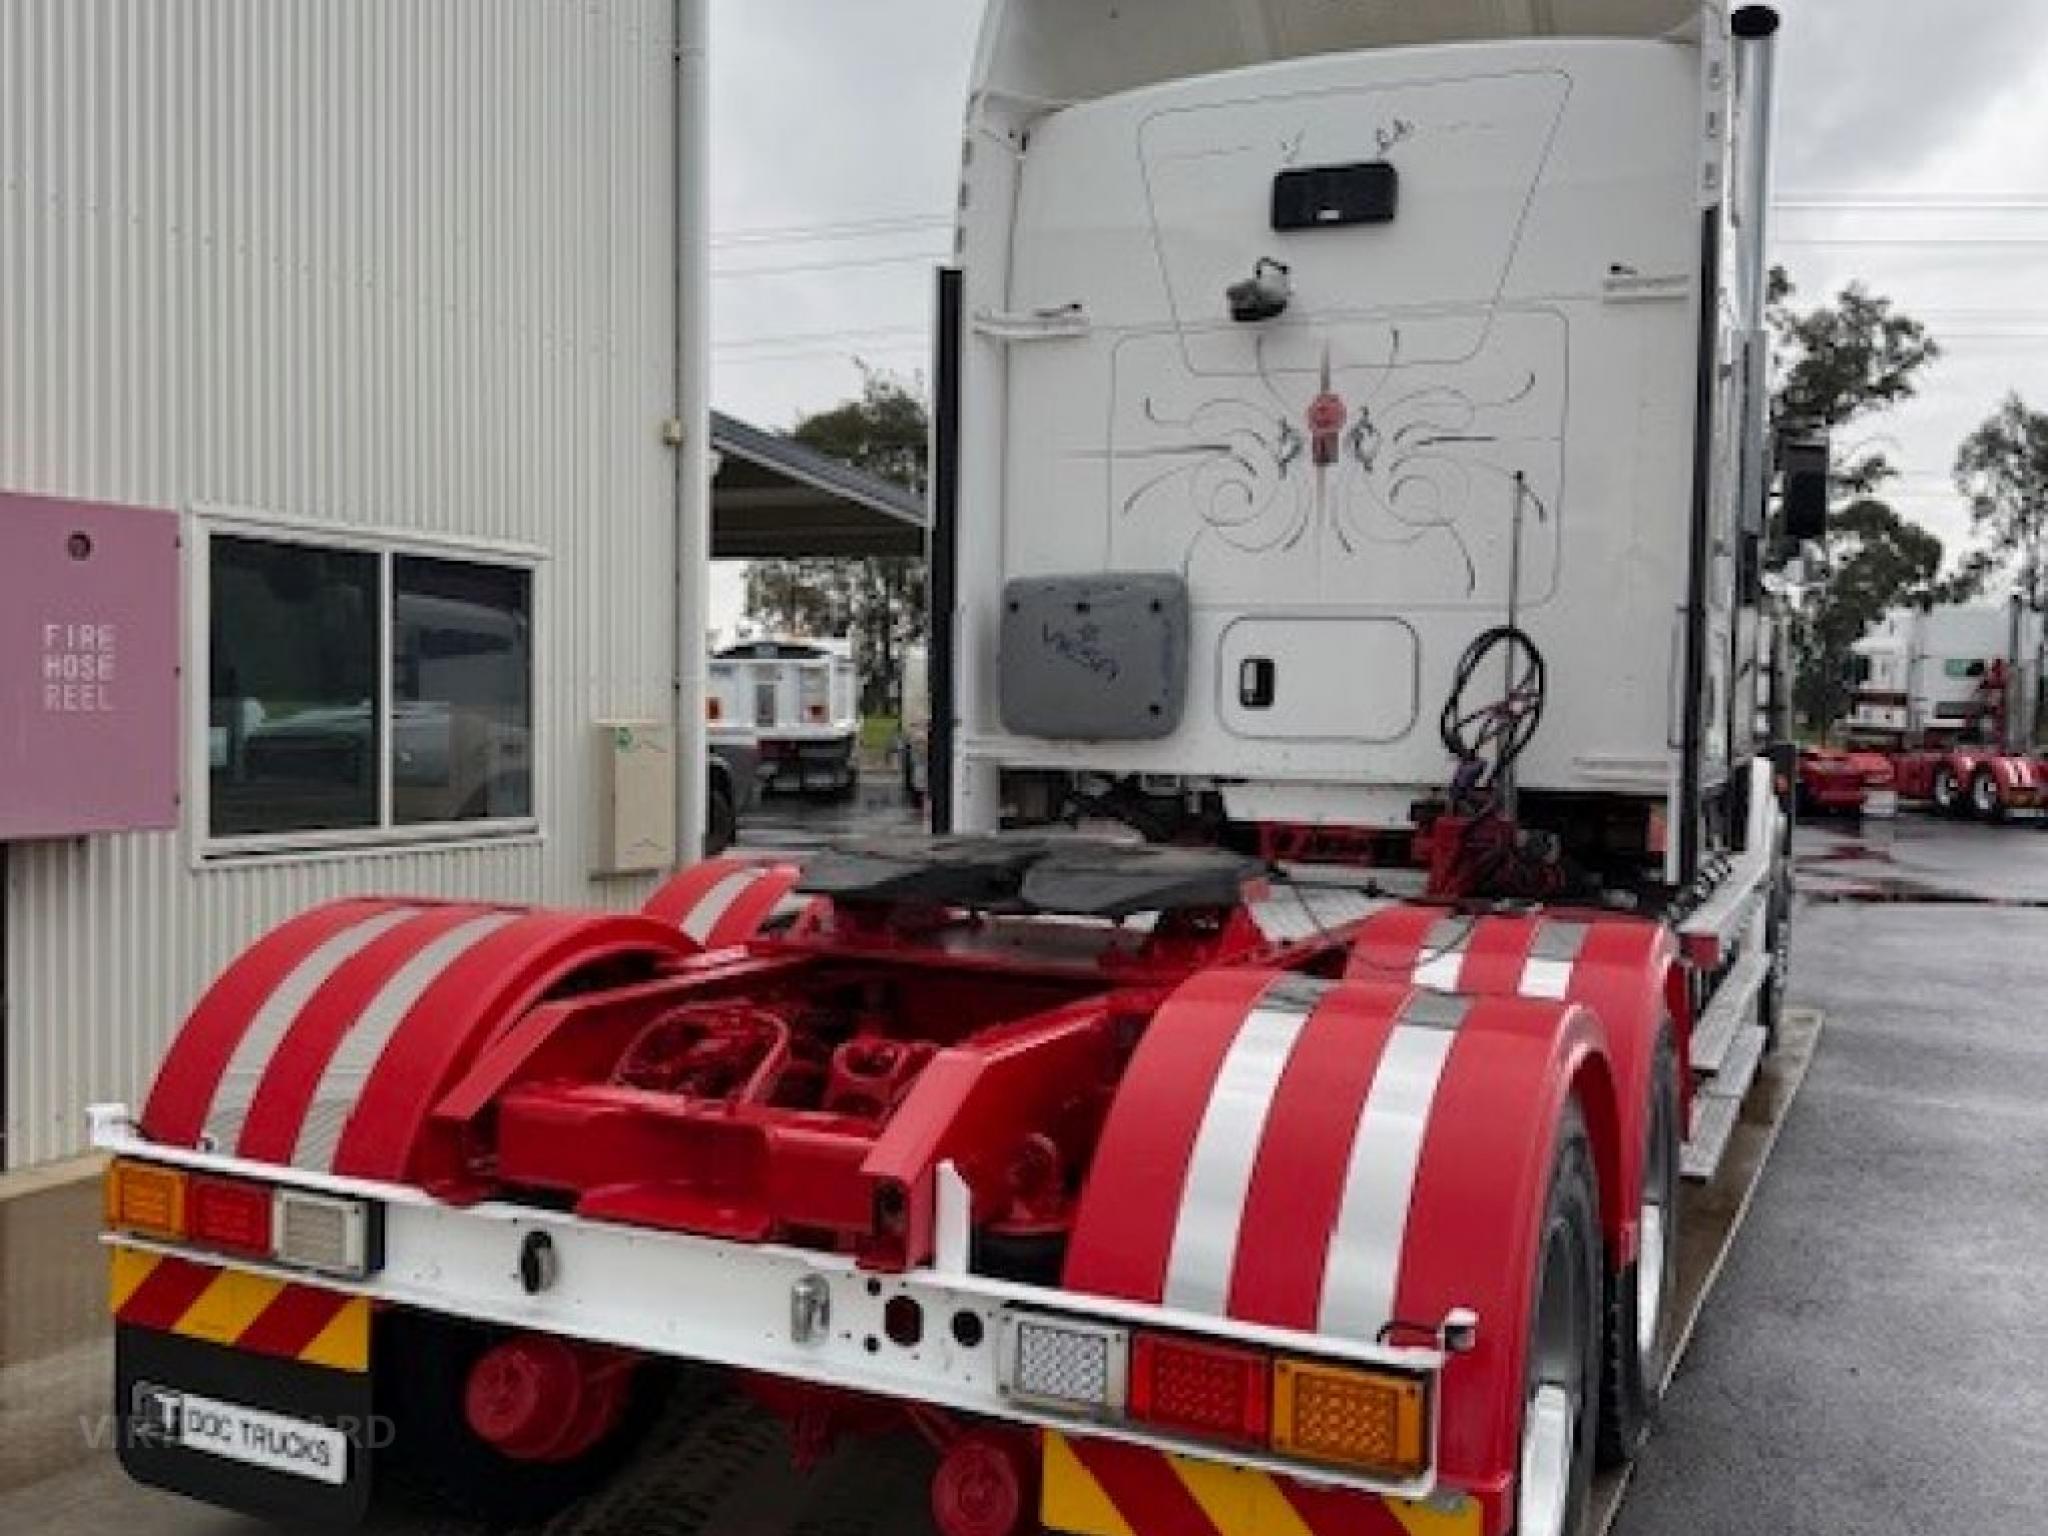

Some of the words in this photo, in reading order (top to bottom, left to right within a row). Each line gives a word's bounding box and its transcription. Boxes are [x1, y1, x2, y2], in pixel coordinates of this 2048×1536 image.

[45, 624, 114, 650] FIRE
[44, 654, 114, 681] HOSE
[45, 684, 113, 711] REEL
[240, 1418, 331, 1467] TRUCKS
